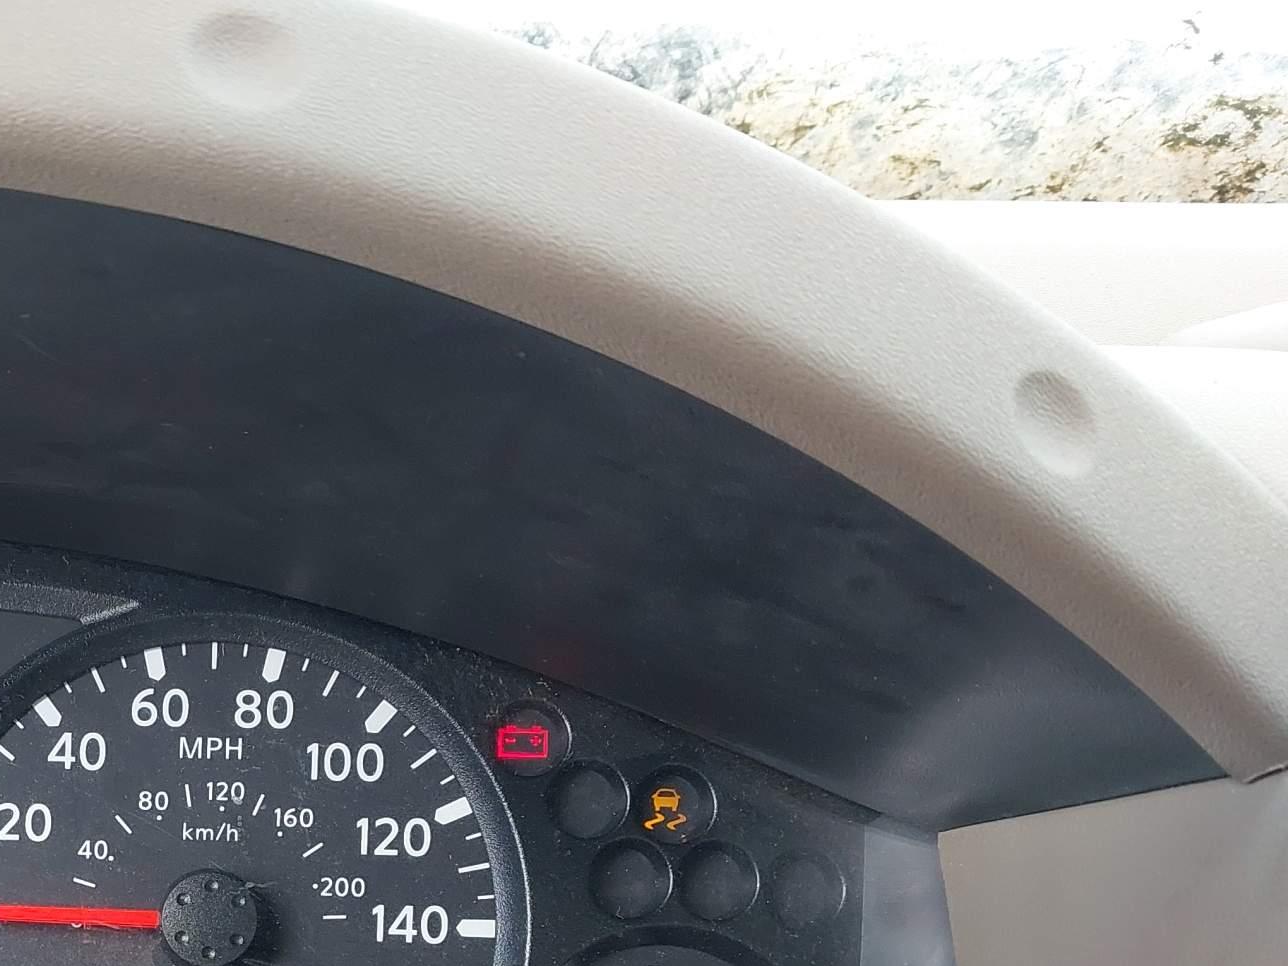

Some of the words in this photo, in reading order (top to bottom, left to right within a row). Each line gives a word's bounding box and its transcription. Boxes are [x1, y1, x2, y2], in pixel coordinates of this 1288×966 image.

[132, 689, 189, 727] 60
[234, 690, 293, 729] 80
[48, 733, 105, 771] 40
[179, 738, 243, 759] MPH
[308, 743, 383, 782] 100
[138, 791, 168, 811] 80
[207, 782, 244, 801] 120
[275, 807, 313, 828] 160
[182, 822, 238, 842] km/h
[357, 818, 431, 857] 120
[77, 841, 108, 859] 40
[320, 877, 364, 898] 200
[373, 905, 448, 944] 140
